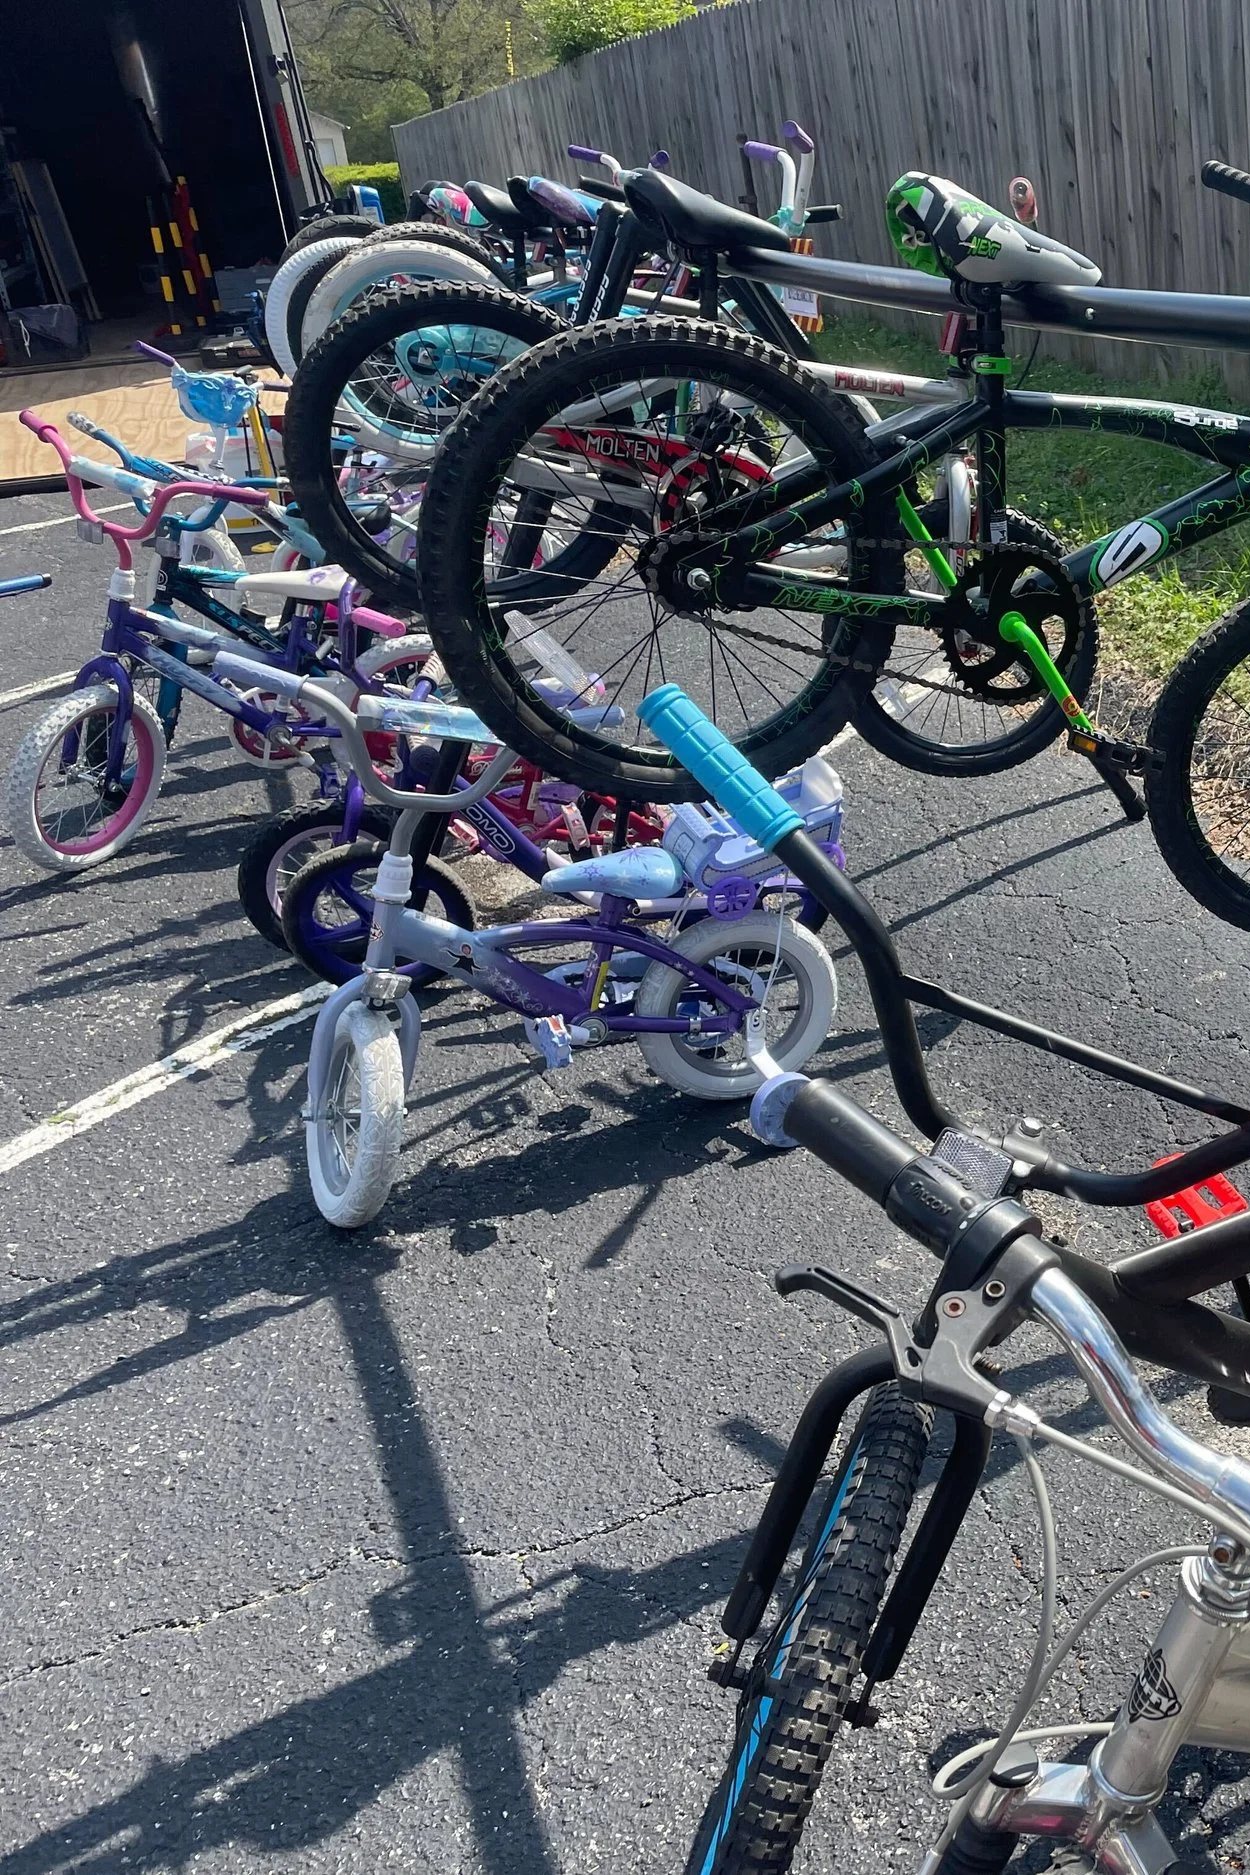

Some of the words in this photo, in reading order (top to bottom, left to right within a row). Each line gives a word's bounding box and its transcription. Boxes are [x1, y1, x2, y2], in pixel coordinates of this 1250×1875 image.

[967, 236, 1002, 258] NEXT
[834, 371, 905, 397] MOLTEN
[586, 434, 660, 463] MOLTEN
[771, 587, 890, 616] NEXT
